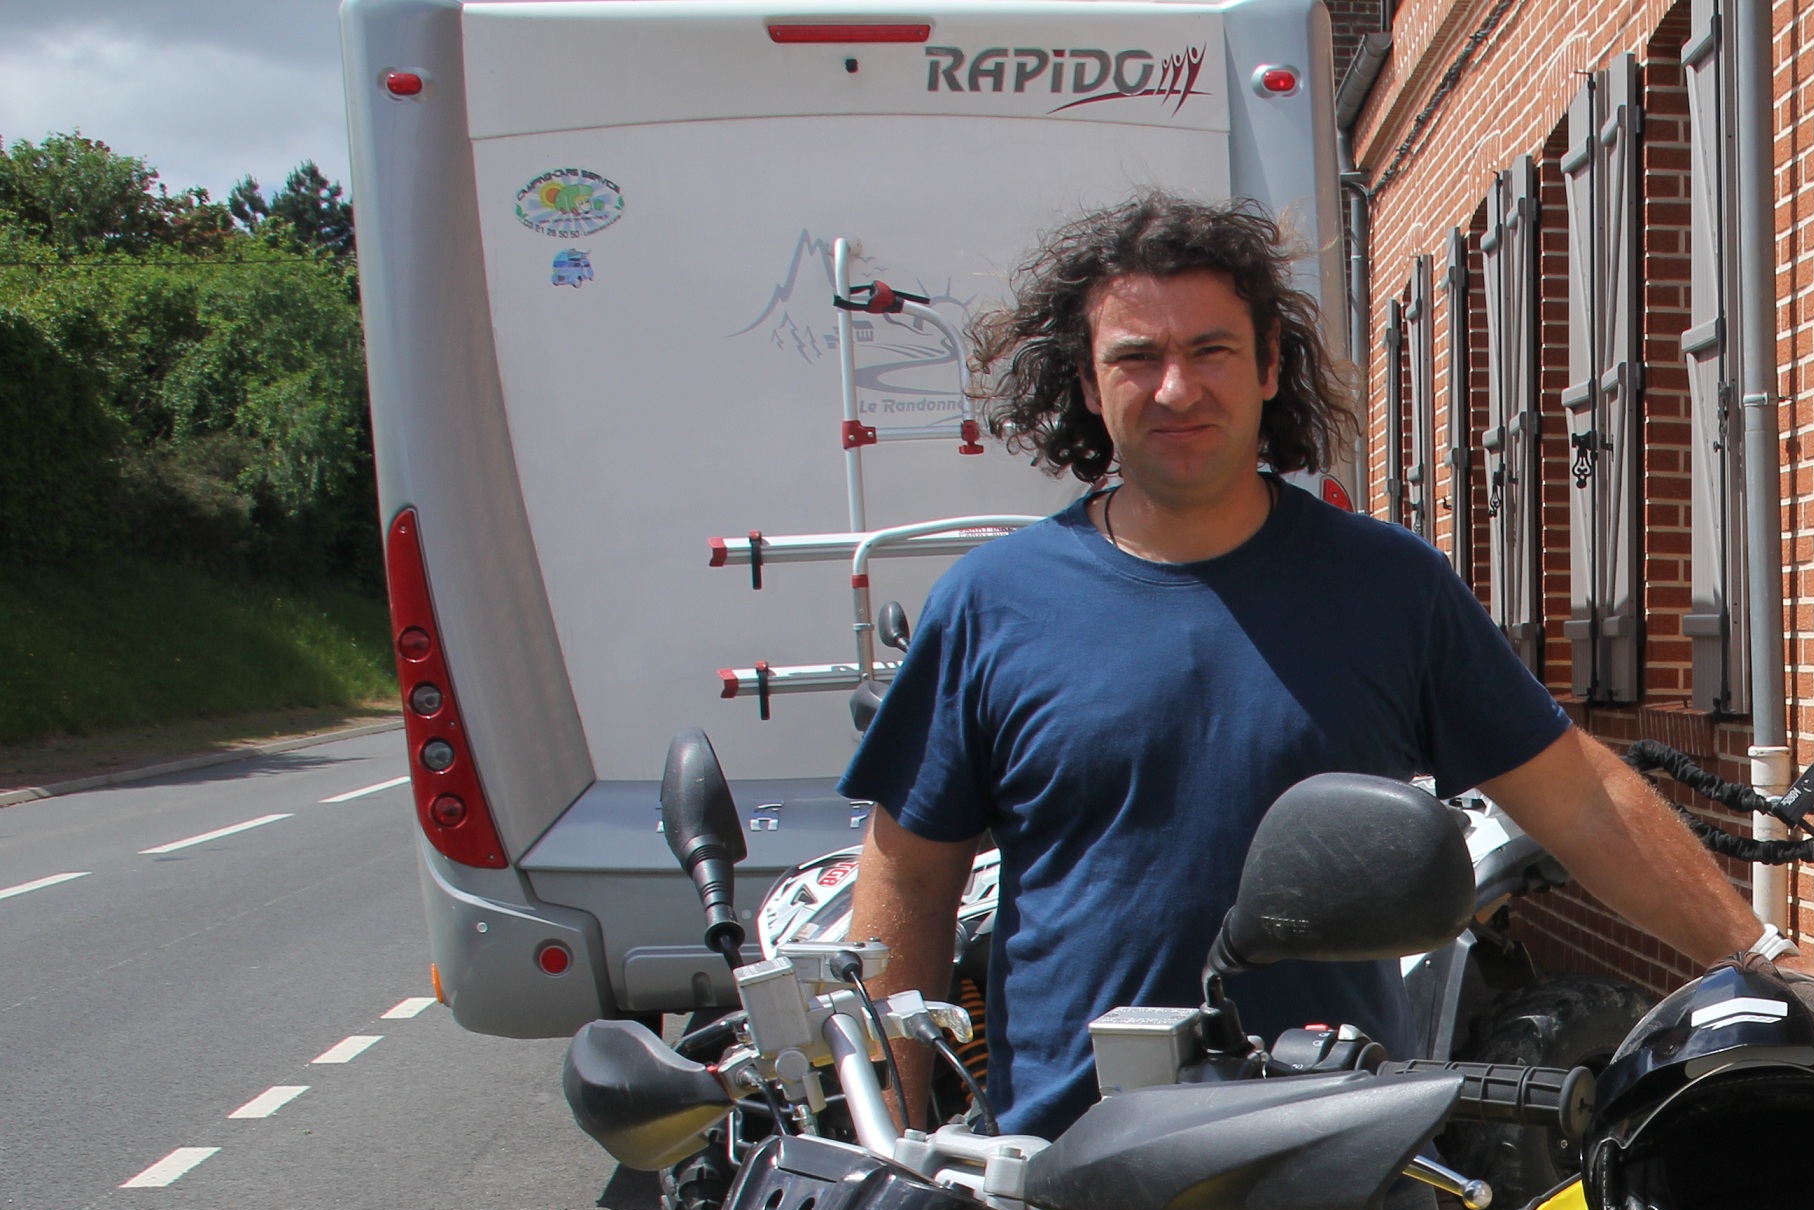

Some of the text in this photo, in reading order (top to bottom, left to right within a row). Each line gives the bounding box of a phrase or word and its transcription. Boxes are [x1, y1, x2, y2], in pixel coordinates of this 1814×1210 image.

[581, 169, 620, 194] SERVICE
[535, 224, 544, 235] 21
[559, 230, 568, 238] 50
[570, 230, 579, 238] 50
[859, 400, 877, 413] Le
[819, 862, 858, 887] TGB
